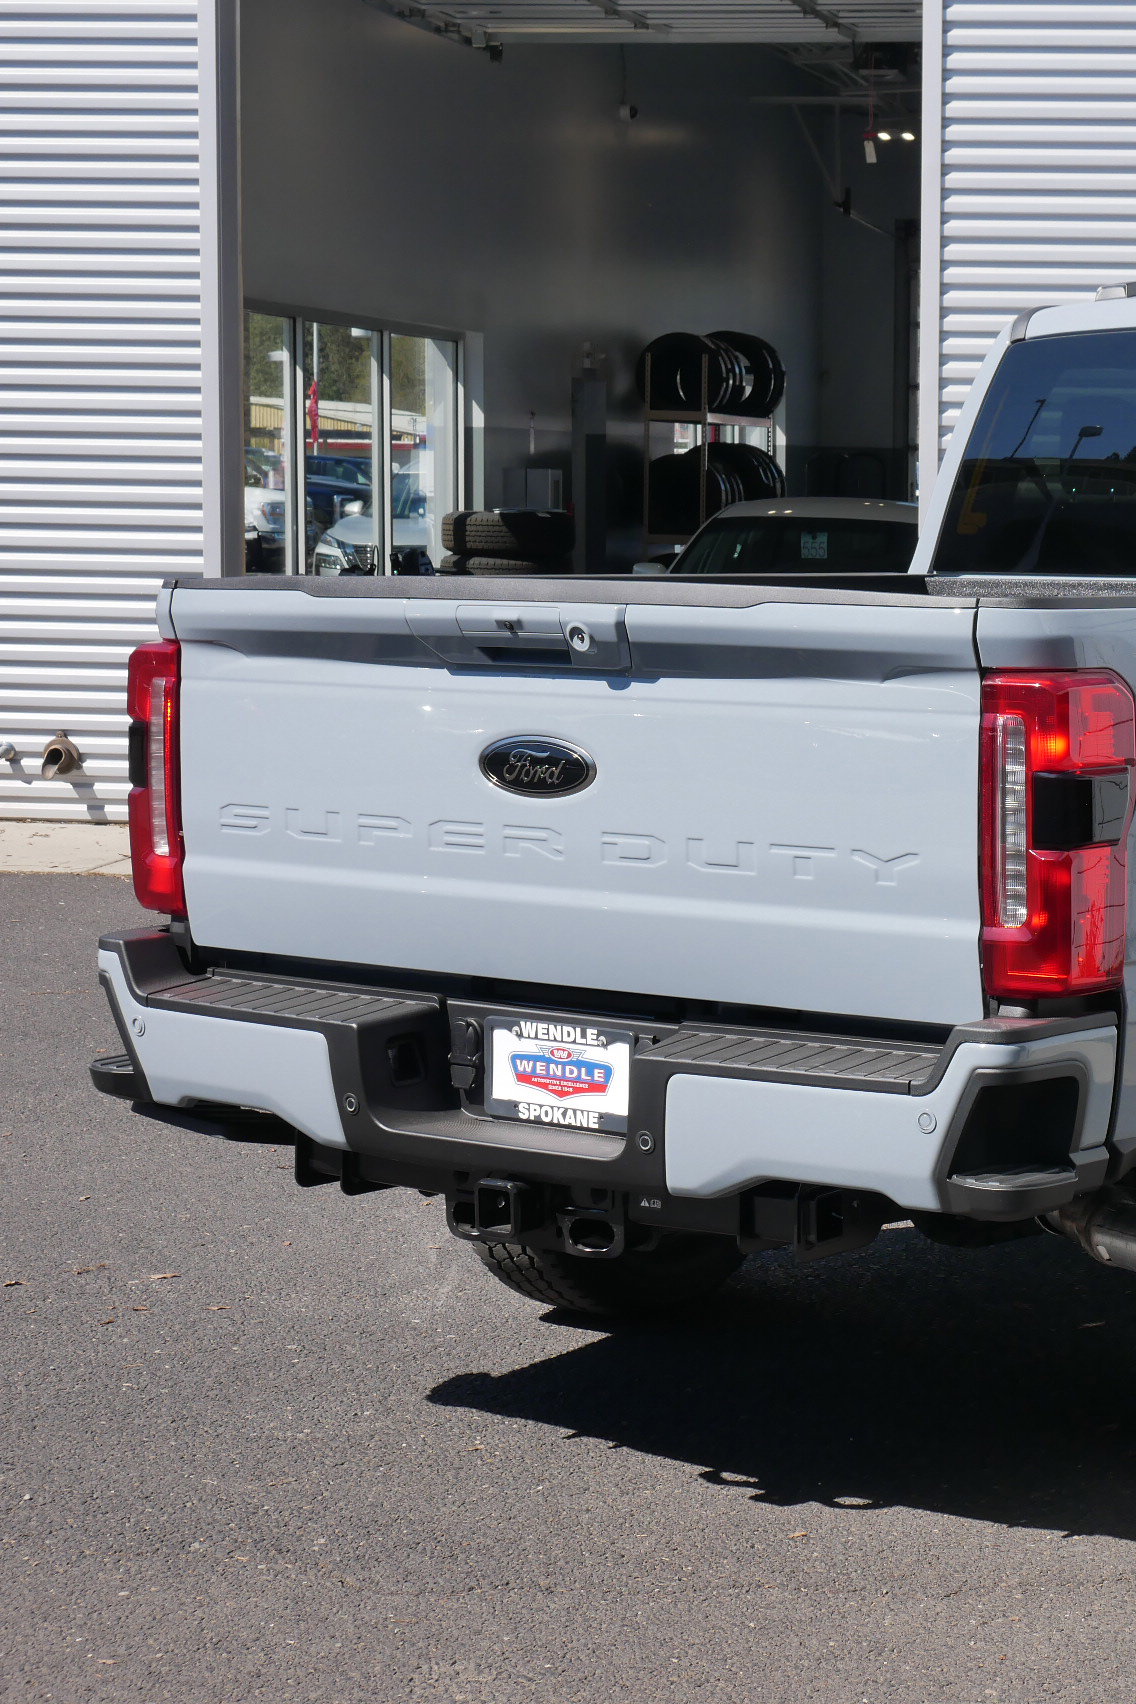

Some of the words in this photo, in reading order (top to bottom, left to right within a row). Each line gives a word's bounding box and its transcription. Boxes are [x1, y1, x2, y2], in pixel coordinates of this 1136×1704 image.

[503, 748, 566, 785] Ford
[218, 802, 567, 862] SUPER
[600, 830, 921, 887] DUTY
[520, 1021, 598, 1045] WENDLE
[516, 1059, 605, 1081] WENDLE
[518, 1103, 599, 1128] SPOKANE
